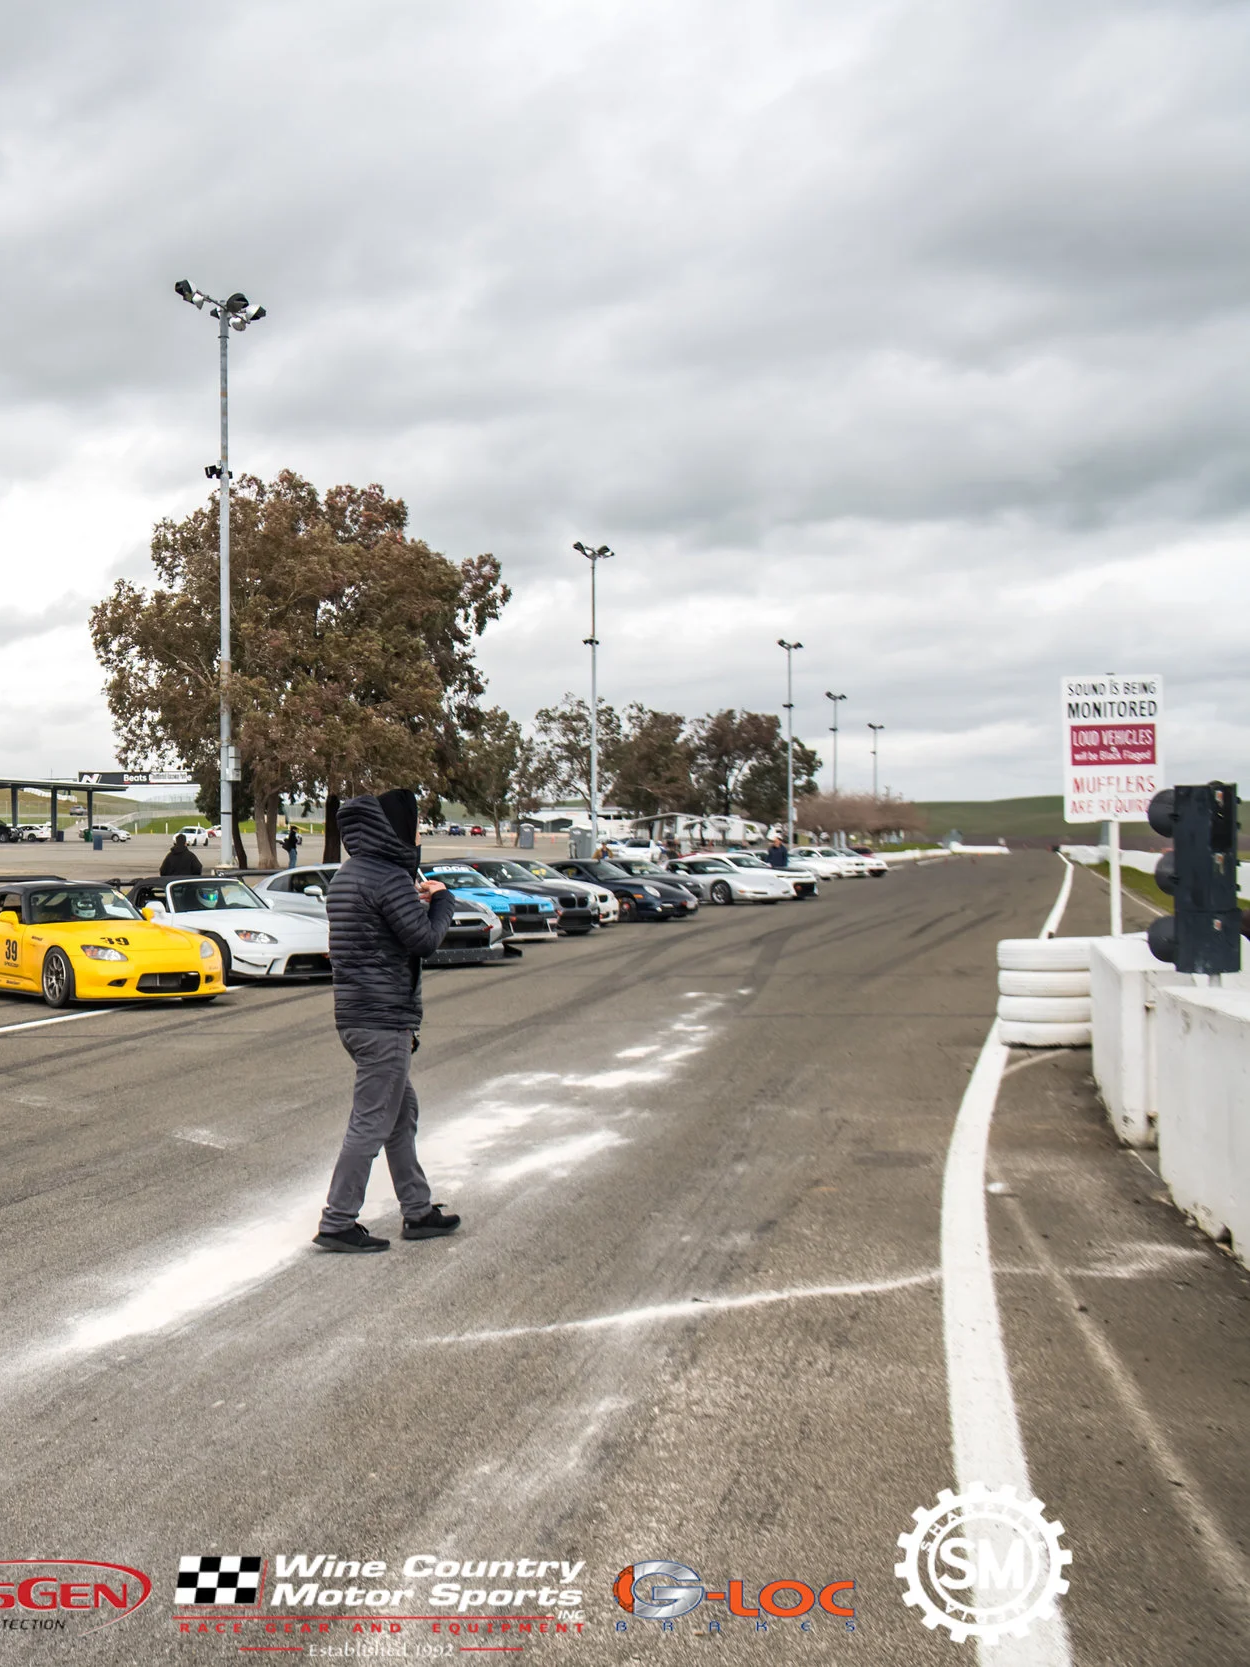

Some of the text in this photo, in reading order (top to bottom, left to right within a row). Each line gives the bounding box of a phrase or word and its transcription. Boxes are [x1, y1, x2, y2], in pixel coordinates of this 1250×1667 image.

[1067, 681, 1156, 696] SOUND IS BEING
[1067, 700, 1157, 718] MONITORED
[1072, 729, 1153, 747] LOUD VEHICLES
[1099, 747, 1122, 760] Black
[123, 774, 147, 782] Beats
[1073, 776, 1156, 794] MUFFLERS
[1070, 799, 1151, 814] ARE REQUIRE
[100, 937, 129, 945] 39
[5, 939, 18, 962] 39
